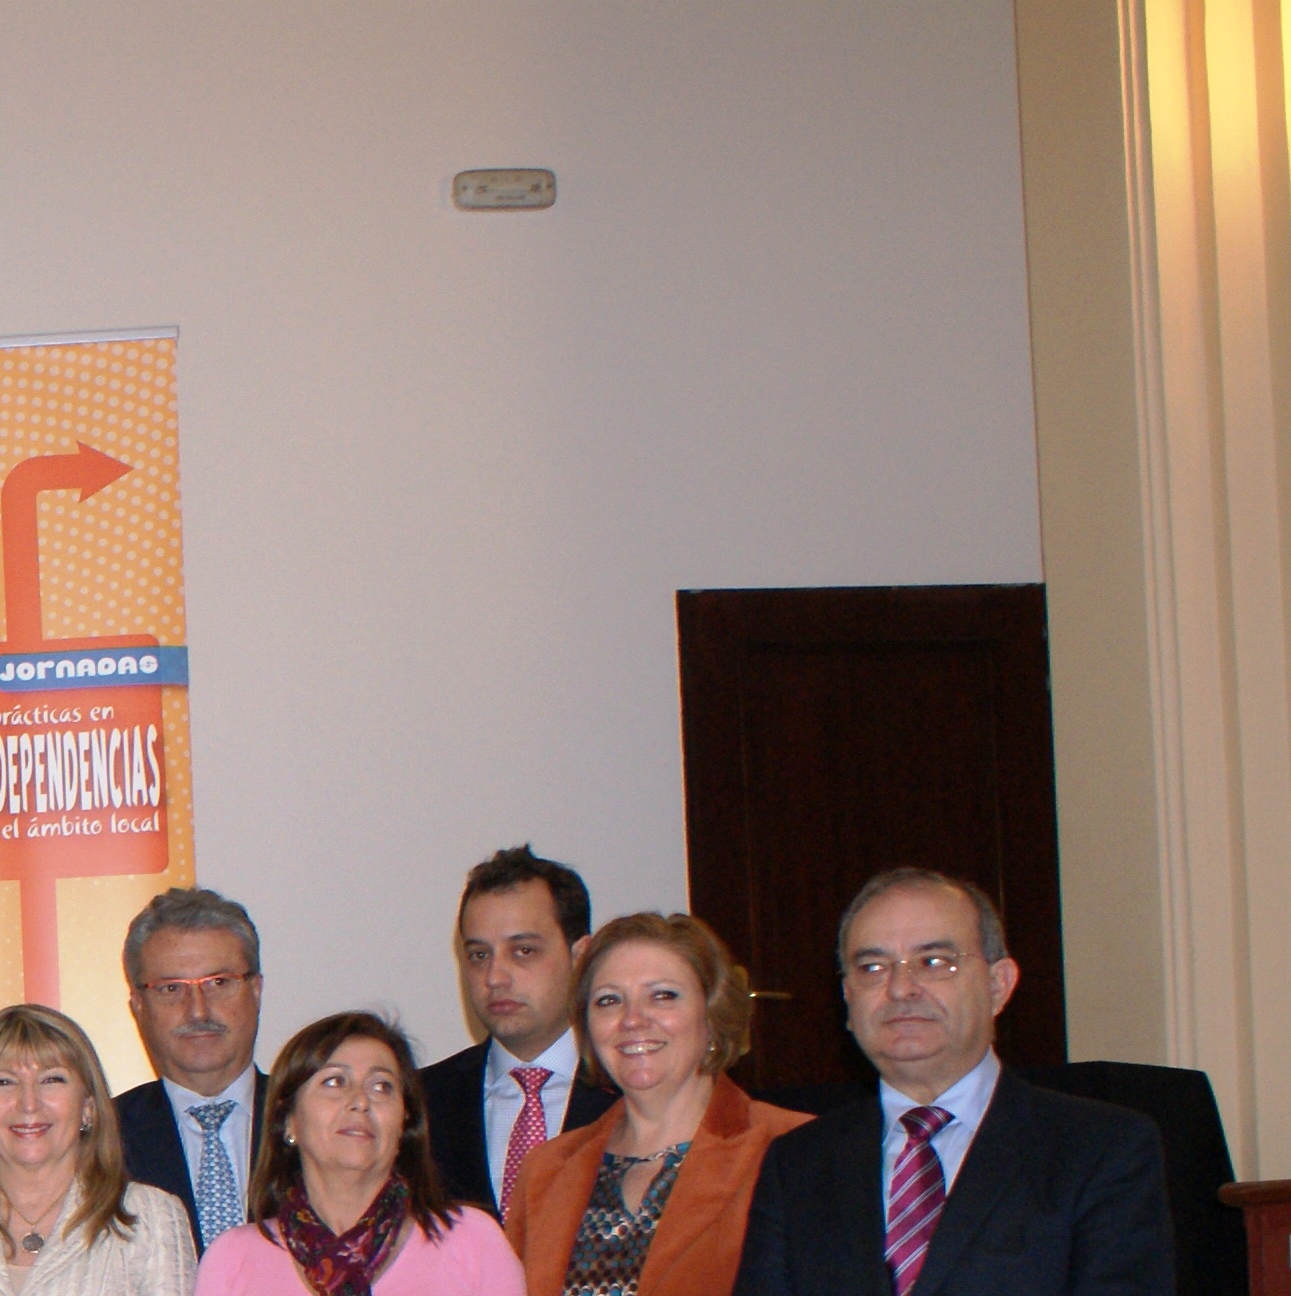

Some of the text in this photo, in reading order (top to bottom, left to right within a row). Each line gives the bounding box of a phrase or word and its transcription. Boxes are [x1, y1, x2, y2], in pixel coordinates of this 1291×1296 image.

[90, 706, 114, 721] en
[1, 818, 19, 839] el
[27, 814, 102, 836] ámbito
[110, 811, 160, 833] local
